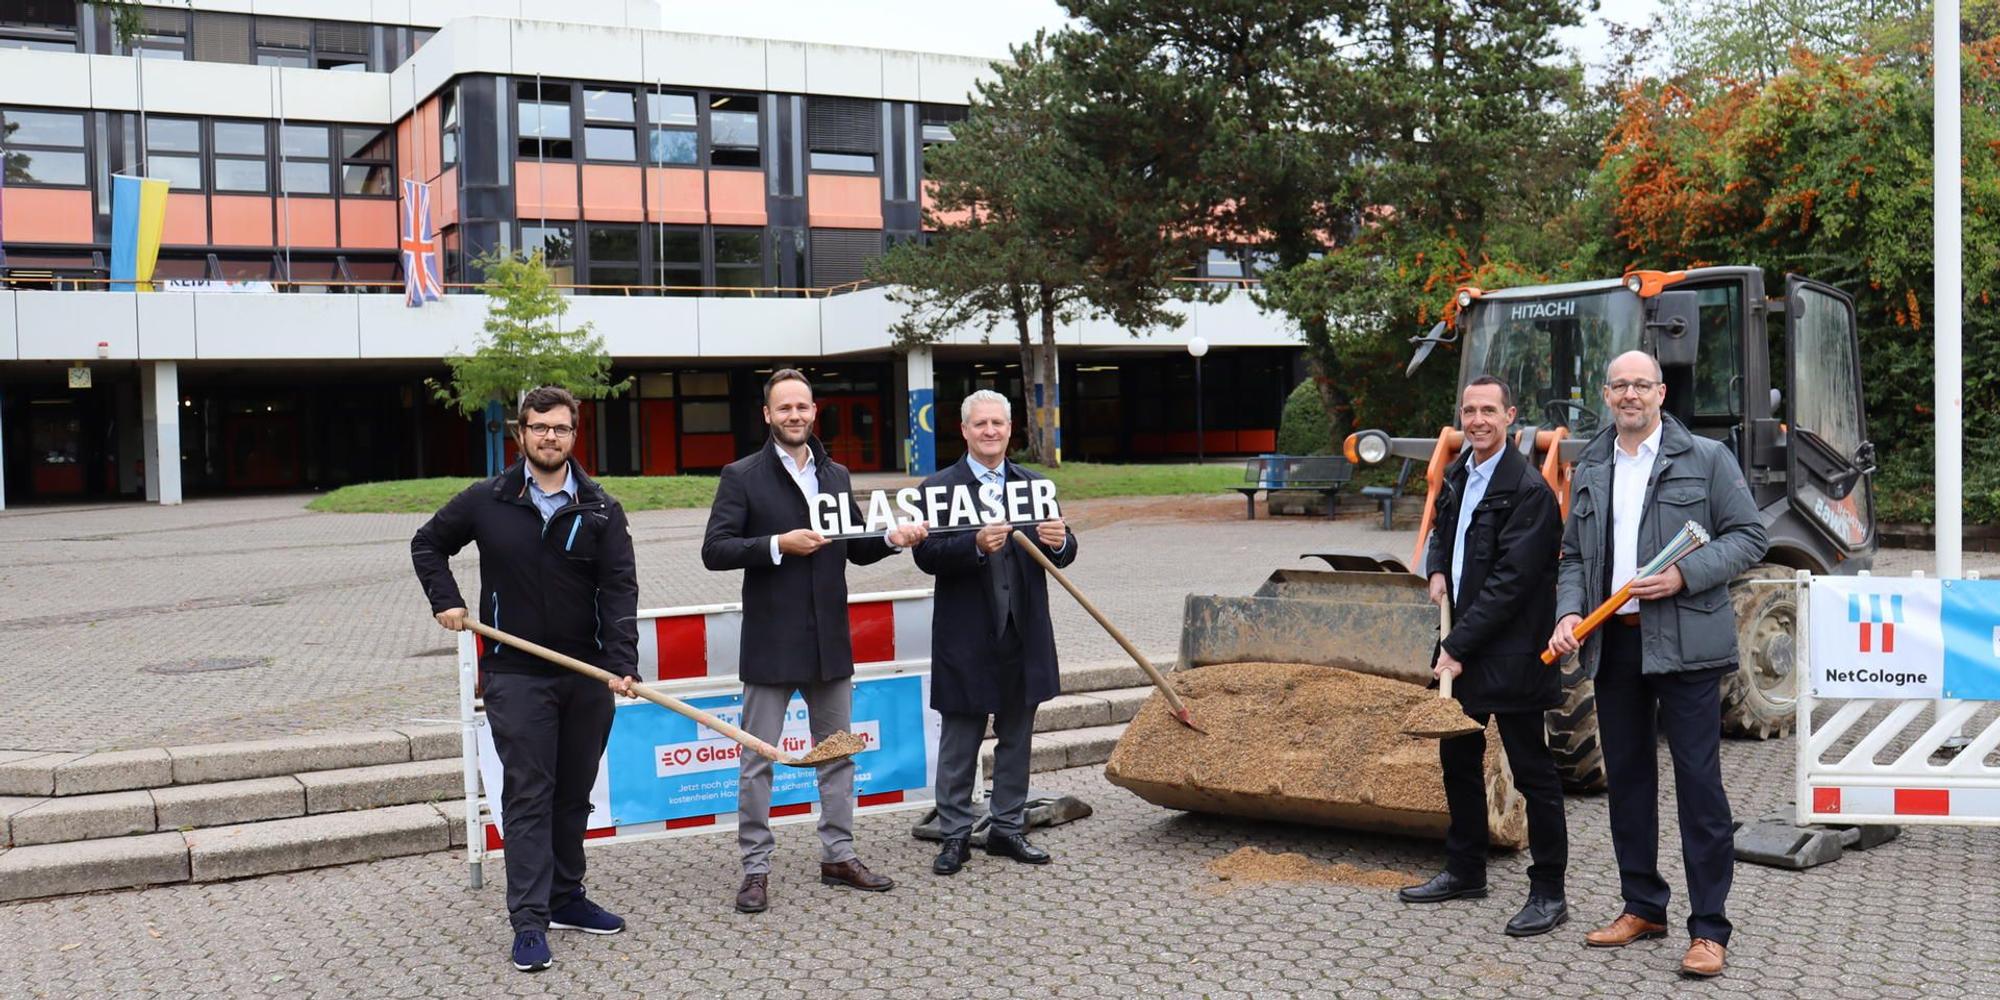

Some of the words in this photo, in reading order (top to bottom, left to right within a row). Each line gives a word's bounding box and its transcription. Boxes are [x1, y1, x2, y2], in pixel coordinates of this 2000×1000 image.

[1511, 301, 1575, 319] HITACHI
[809, 479, 1060, 536] GLASFASER
[1826, 668, 1928, 686] NetCologne
[696, 743, 742, 762] Glasf
[782, 737, 806, 752] für
[678, 784, 699, 793] Jetzt
[701, 780, 721, 790] noch
